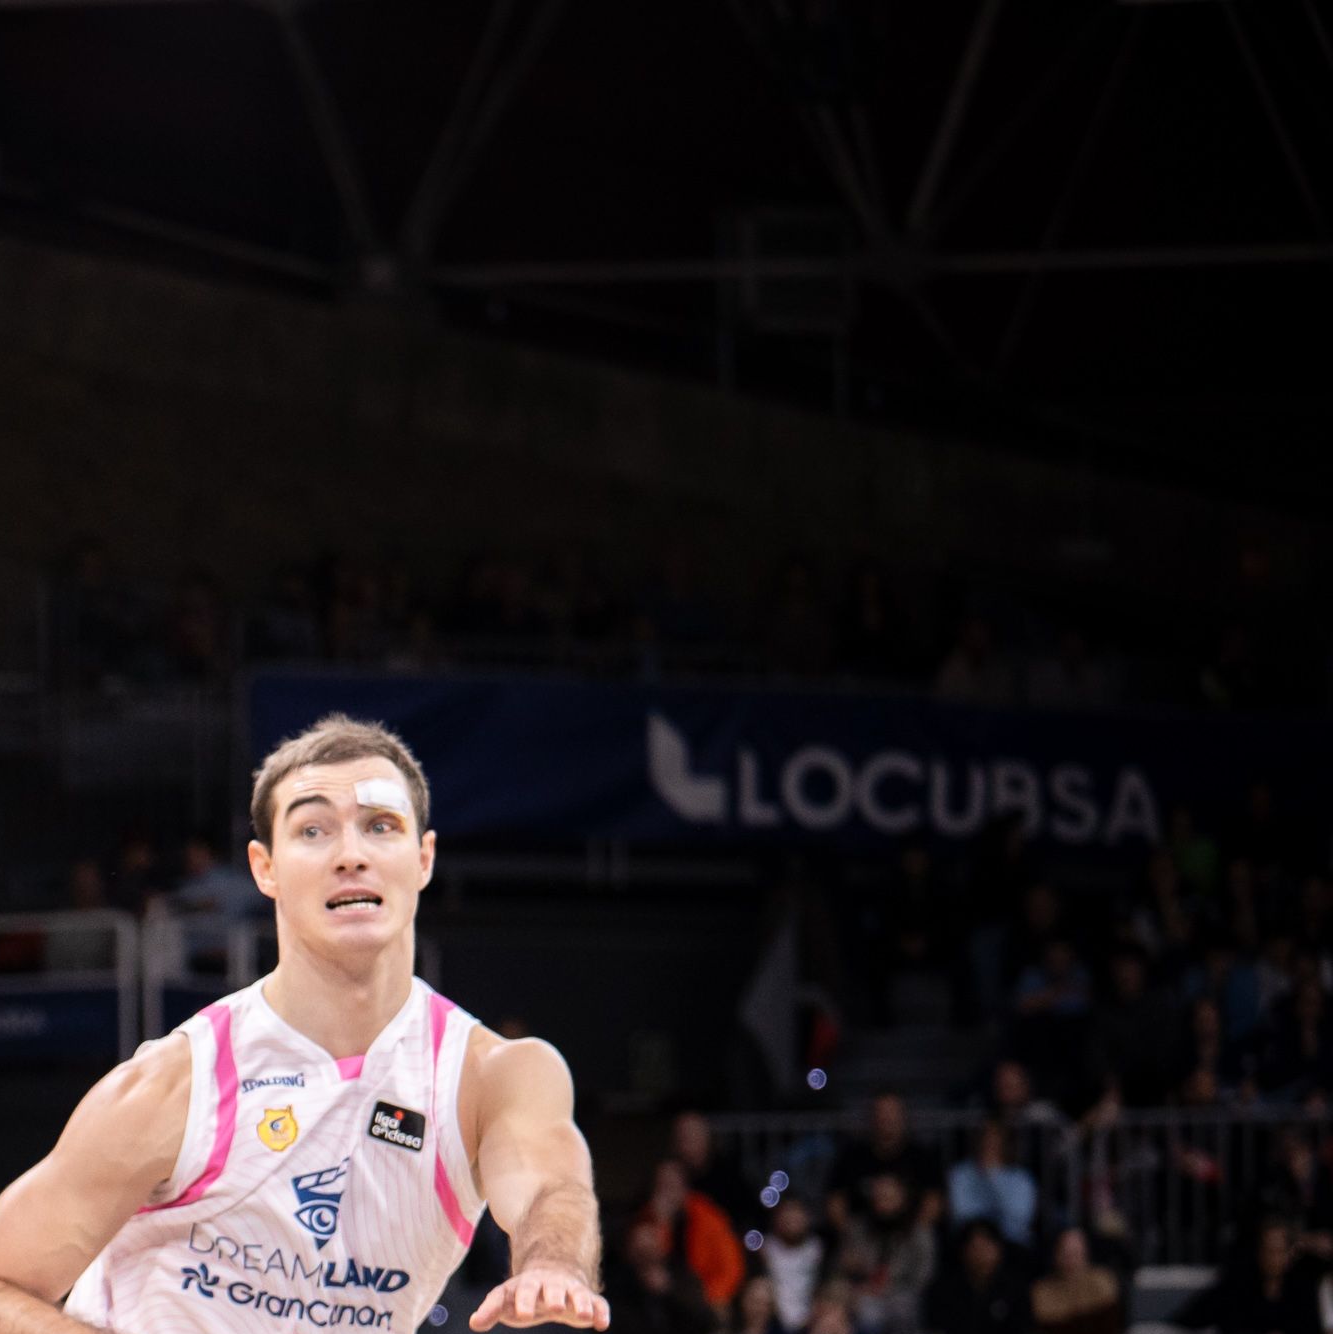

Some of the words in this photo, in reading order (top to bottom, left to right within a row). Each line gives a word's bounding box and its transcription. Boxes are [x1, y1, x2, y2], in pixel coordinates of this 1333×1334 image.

[242, 1072, 306, 1094] SPALDING
[375, 1111, 401, 1129] liga
[371, 1123, 423, 1149] endesa
[188, 1222, 411, 1293] DREAMLAND
